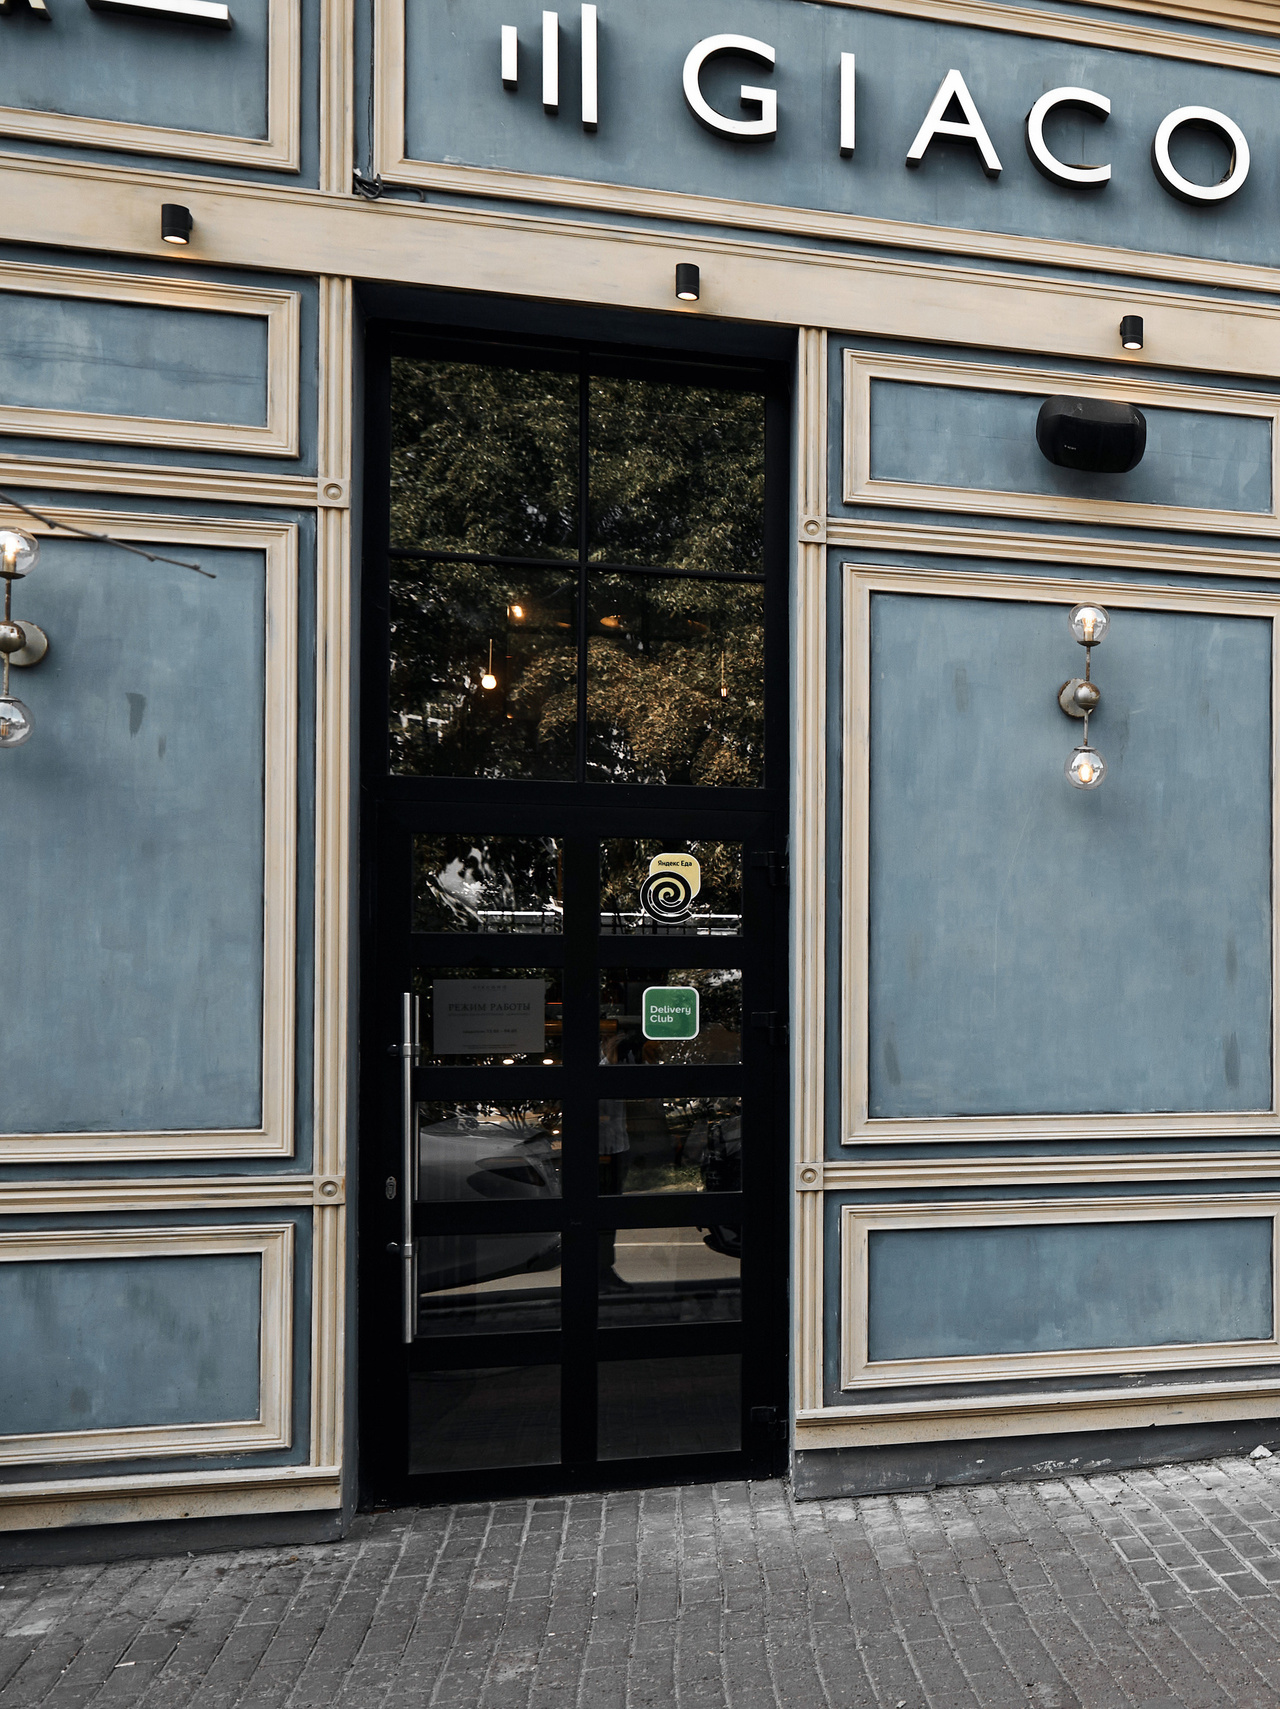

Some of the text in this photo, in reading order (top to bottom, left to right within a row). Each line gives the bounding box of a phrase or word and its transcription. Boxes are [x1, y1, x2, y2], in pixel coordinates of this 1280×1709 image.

[657, 859, 693, 867] Яндекс Еда
[448, 1002, 532, 1012] РЕЖИМ РАБОТЫ
[650, 1005, 691, 1016] Delivery
[650, 1014, 674, 1023] Club
